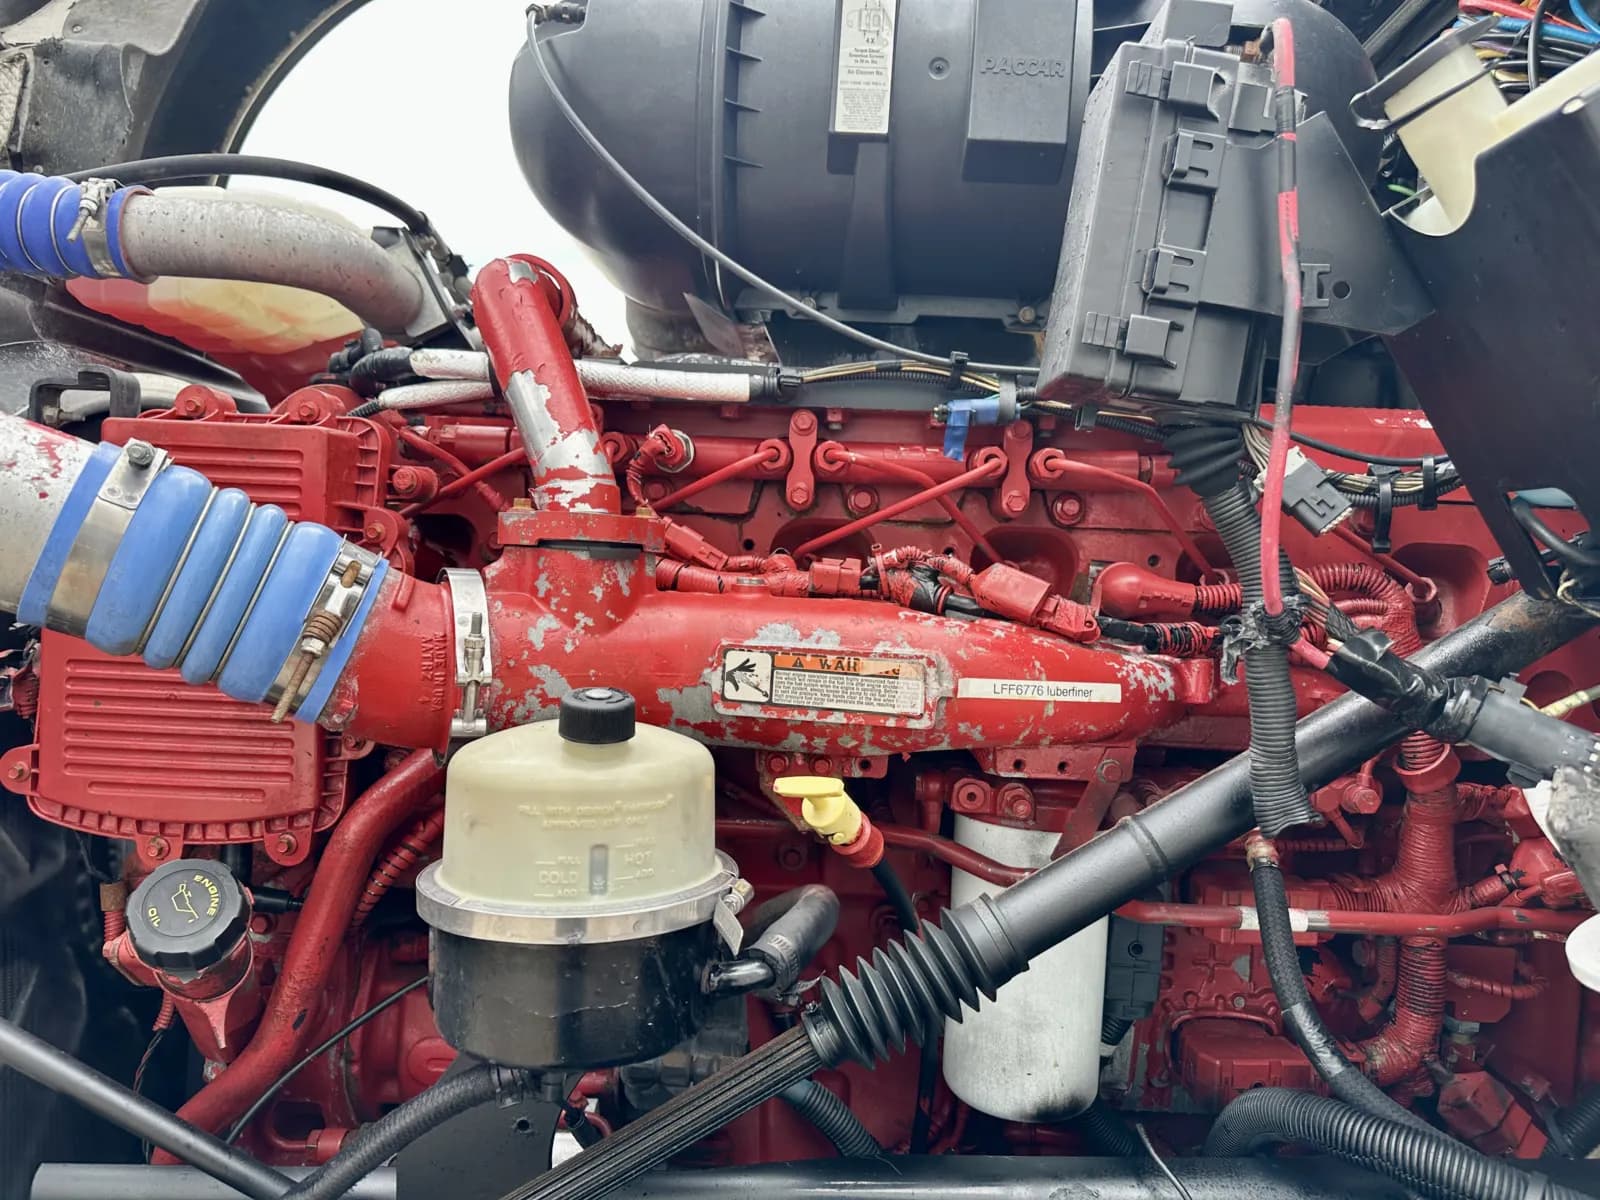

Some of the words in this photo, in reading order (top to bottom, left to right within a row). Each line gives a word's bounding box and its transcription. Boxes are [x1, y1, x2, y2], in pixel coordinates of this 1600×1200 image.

[980, 56, 1065, 78] PACCAR
[434, 632, 448, 668] MADE
[434, 672, 448, 686] IN
[431, 688, 445, 713] USA
[993, 683, 1044, 696] LFF6776
[1046, 684, 1093, 698] luberfiner
[624, 851, 652, 865] HOT
[538, 870, 578, 884] COLD
[193, 874, 220, 917] ENGINE
[148, 906, 161, 928] OIL
